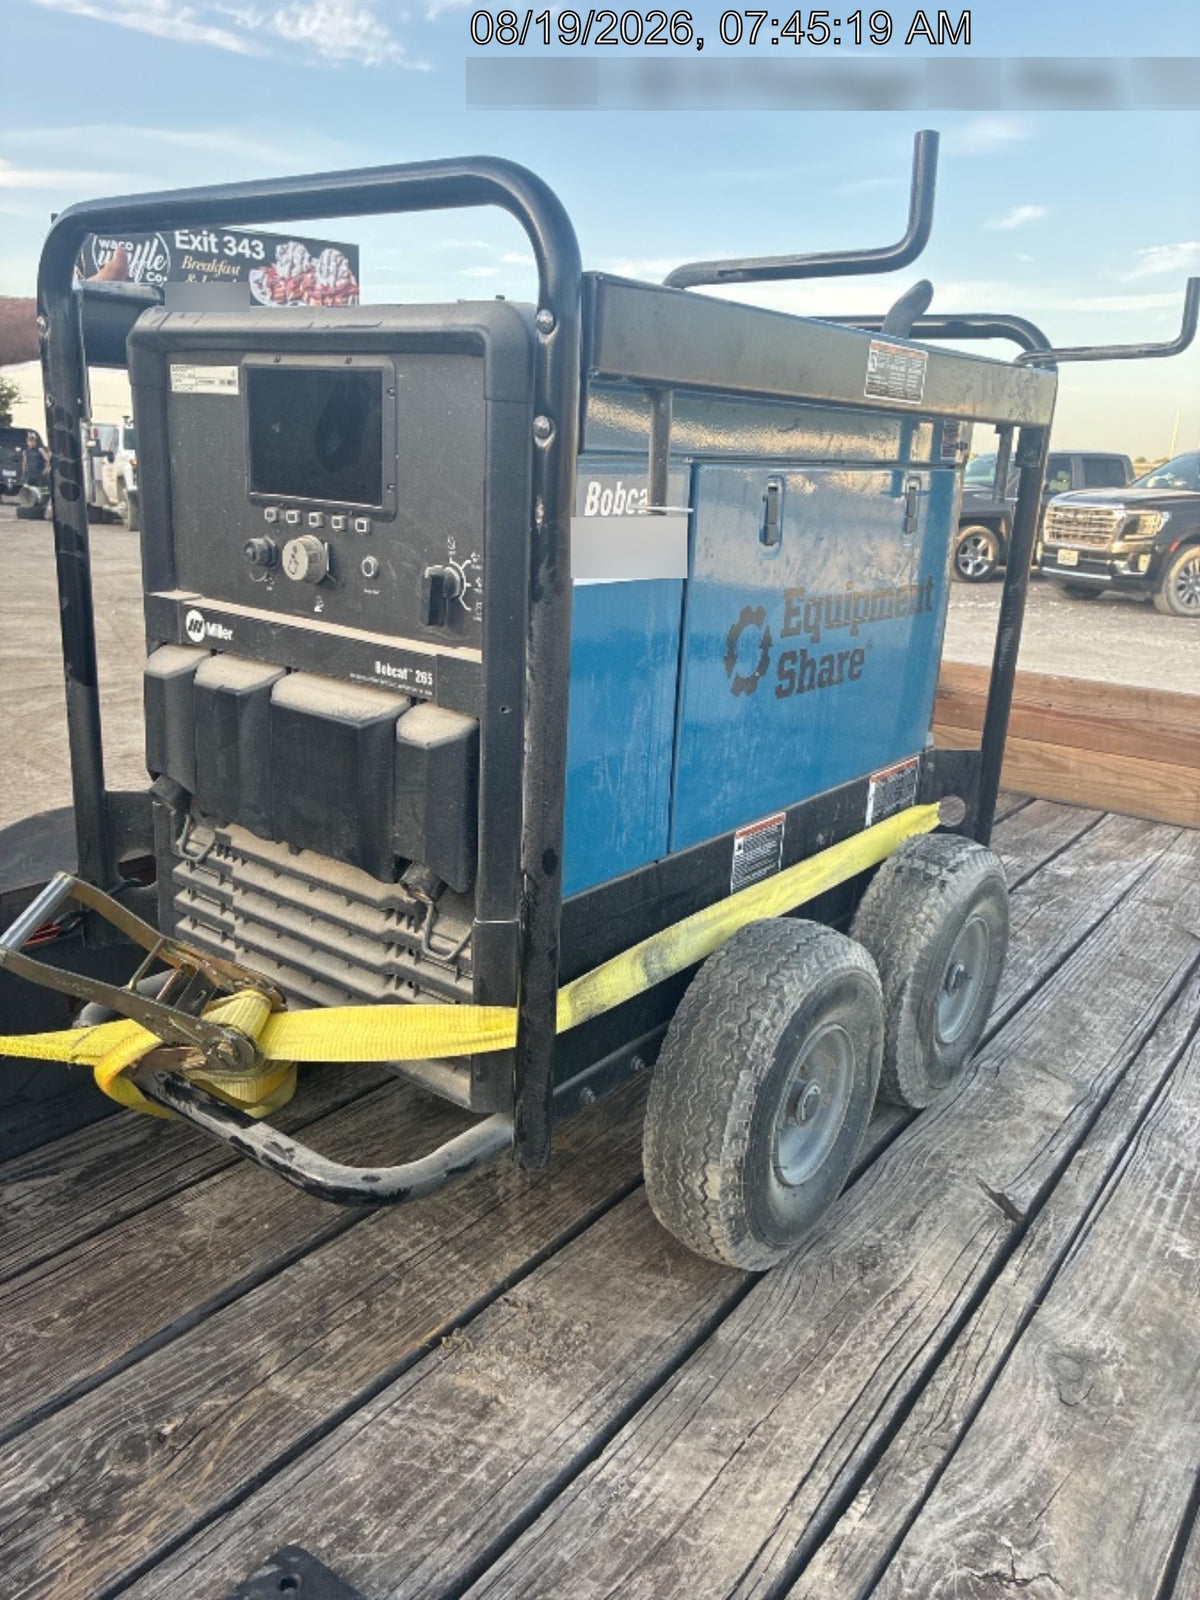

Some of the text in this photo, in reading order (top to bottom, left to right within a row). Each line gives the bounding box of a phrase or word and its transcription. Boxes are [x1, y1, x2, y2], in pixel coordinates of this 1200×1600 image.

[173, 229, 266, 260] Exit 343
[181, 255, 241, 277] Breakfast
[584, 481, 649, 517] Bobca
[780, 575, 935, 644] Equipment
[205, 621, 234, 641] Miller
[415, 669, 433, 686] 265
[774, 646, 866, 699] Share
